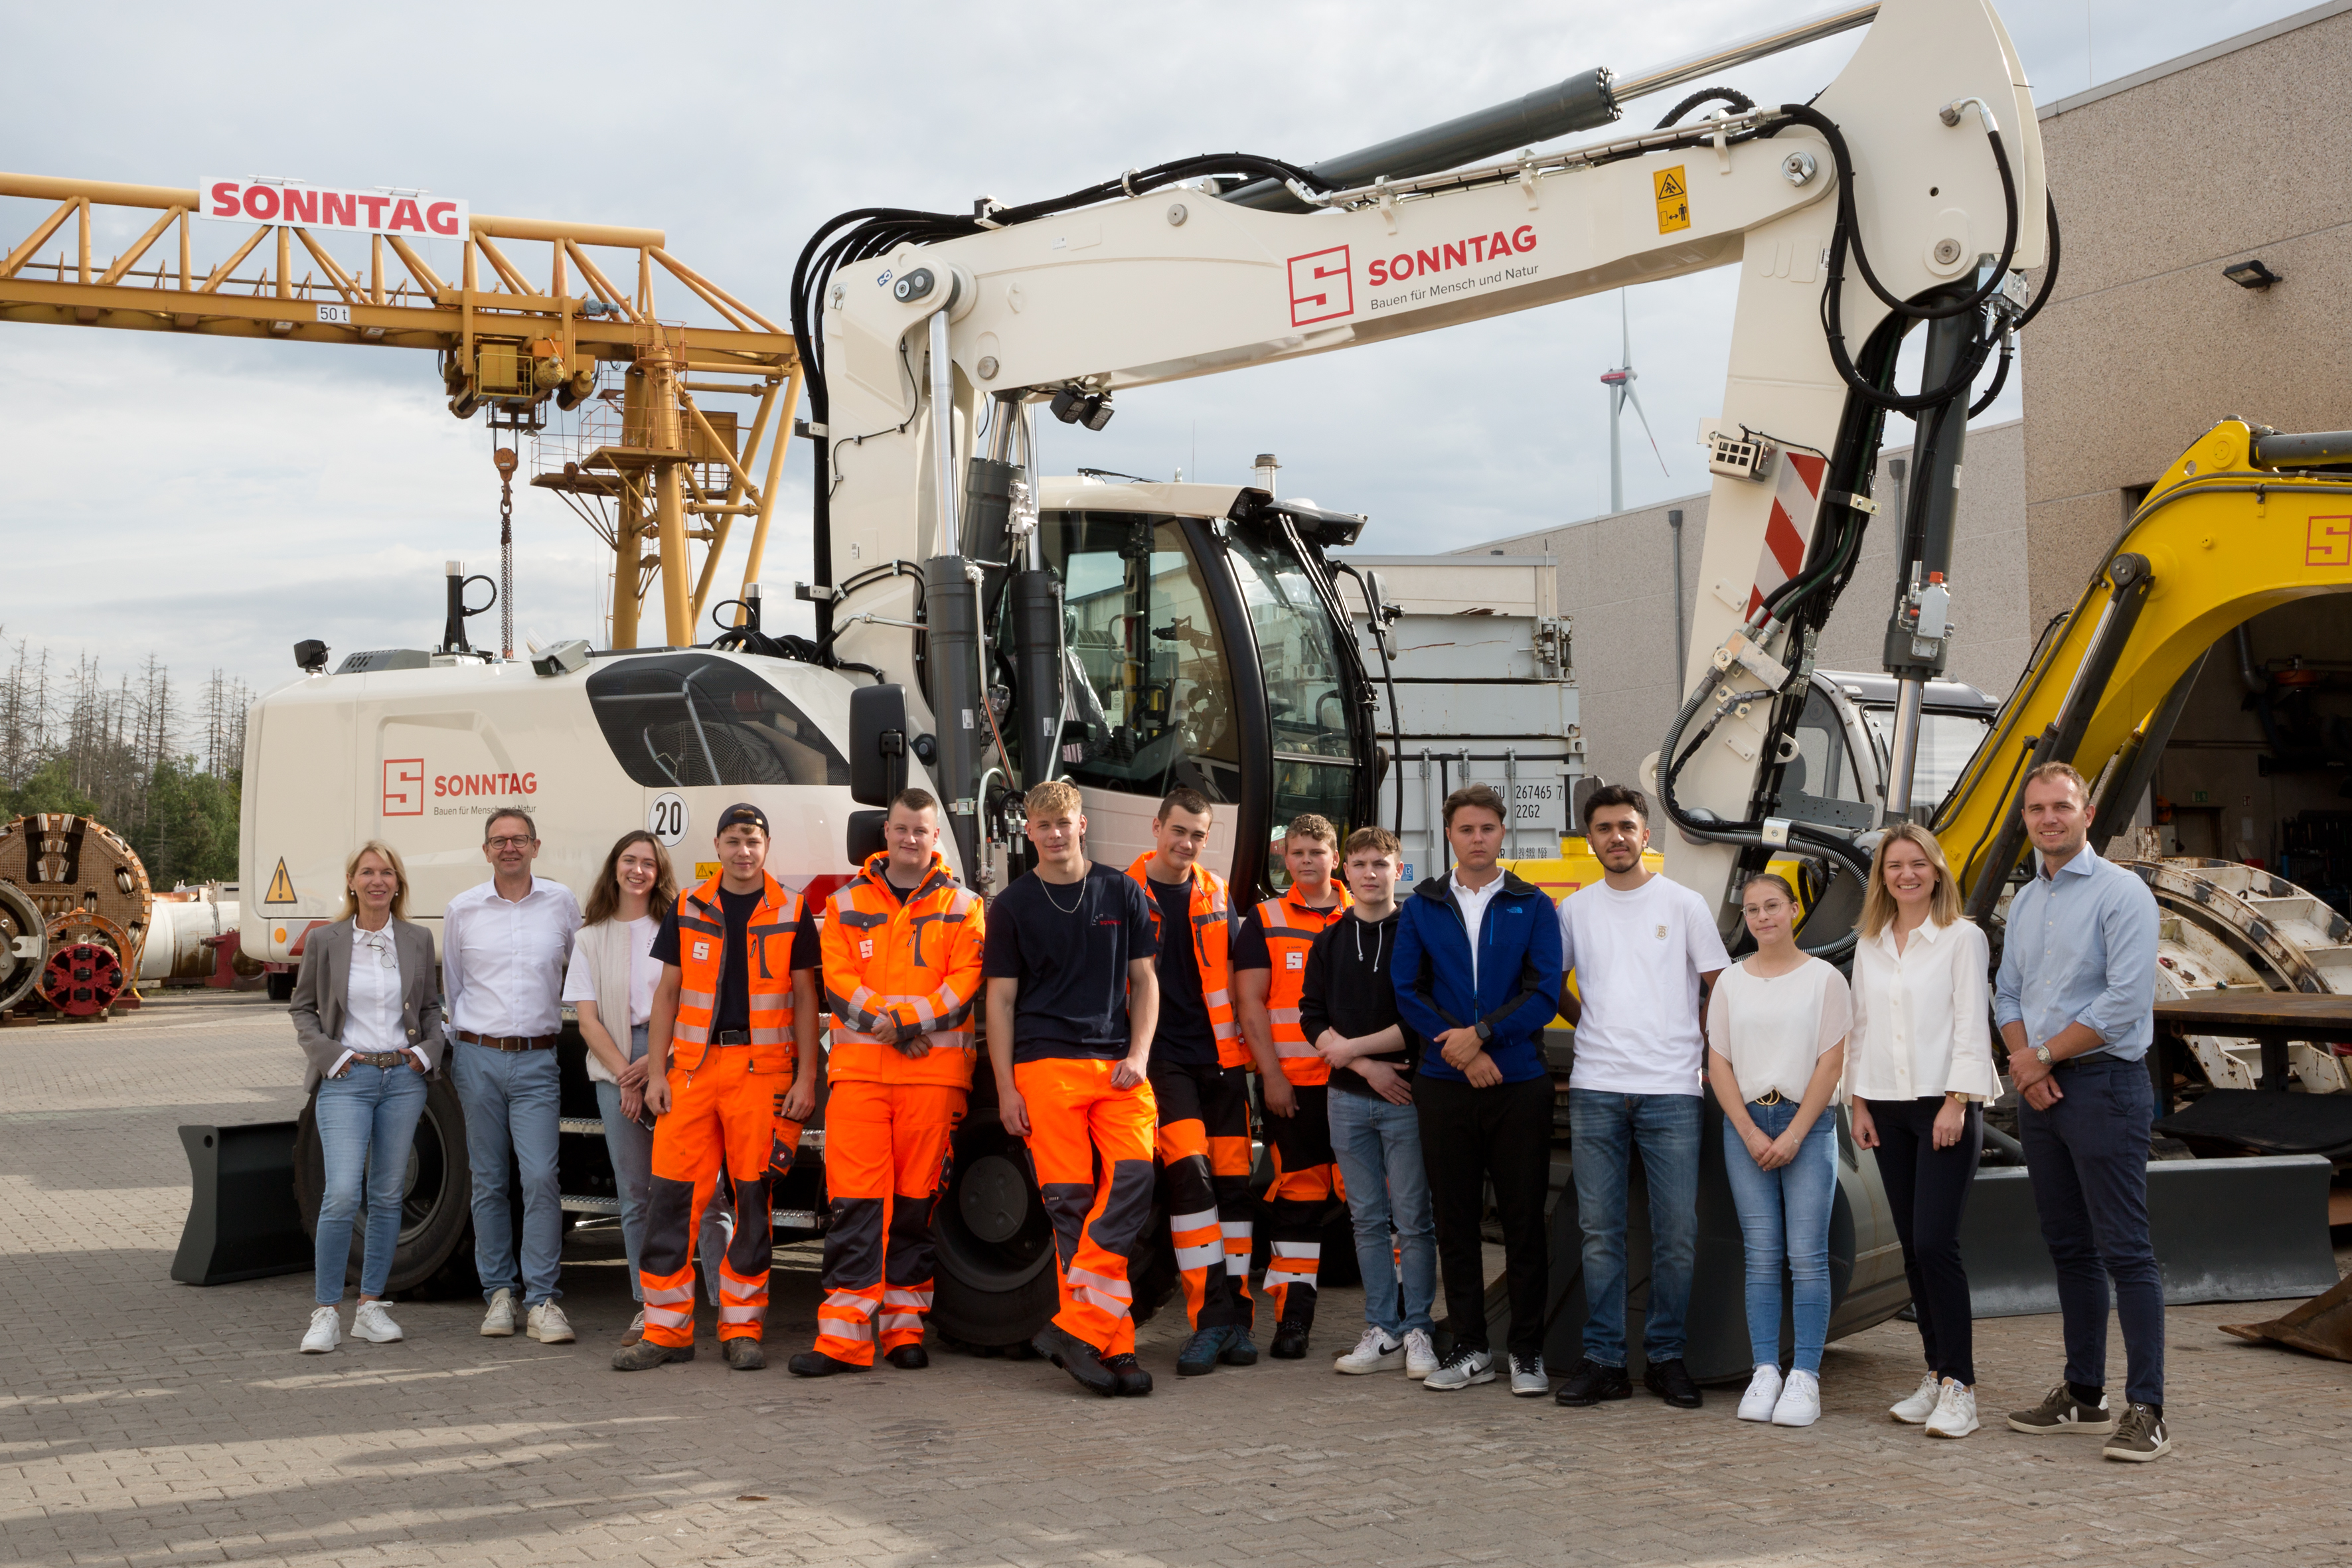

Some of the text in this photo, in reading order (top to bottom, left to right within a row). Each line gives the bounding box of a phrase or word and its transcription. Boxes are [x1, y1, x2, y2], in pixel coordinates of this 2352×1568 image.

[211, 182, 459, 235] SONNTAG
[1368, 224, 1537, 286] SONNTAG
[1371, 264, 1539, 310] Bauen für Mensch und Natur
[321, 307, 347, 321] 50 t
[434, 772, 537, 797] SONNTAG
[1488, 785, 1563, 799] SU 267465 7
[433, 807, 457, 815] Bauen
[459, 806, 469, 815] für
[518, 804, 536, 813] Natur
[655, 801, 681, 835] 20
[1516, 805, 1540, 818] 22G2
